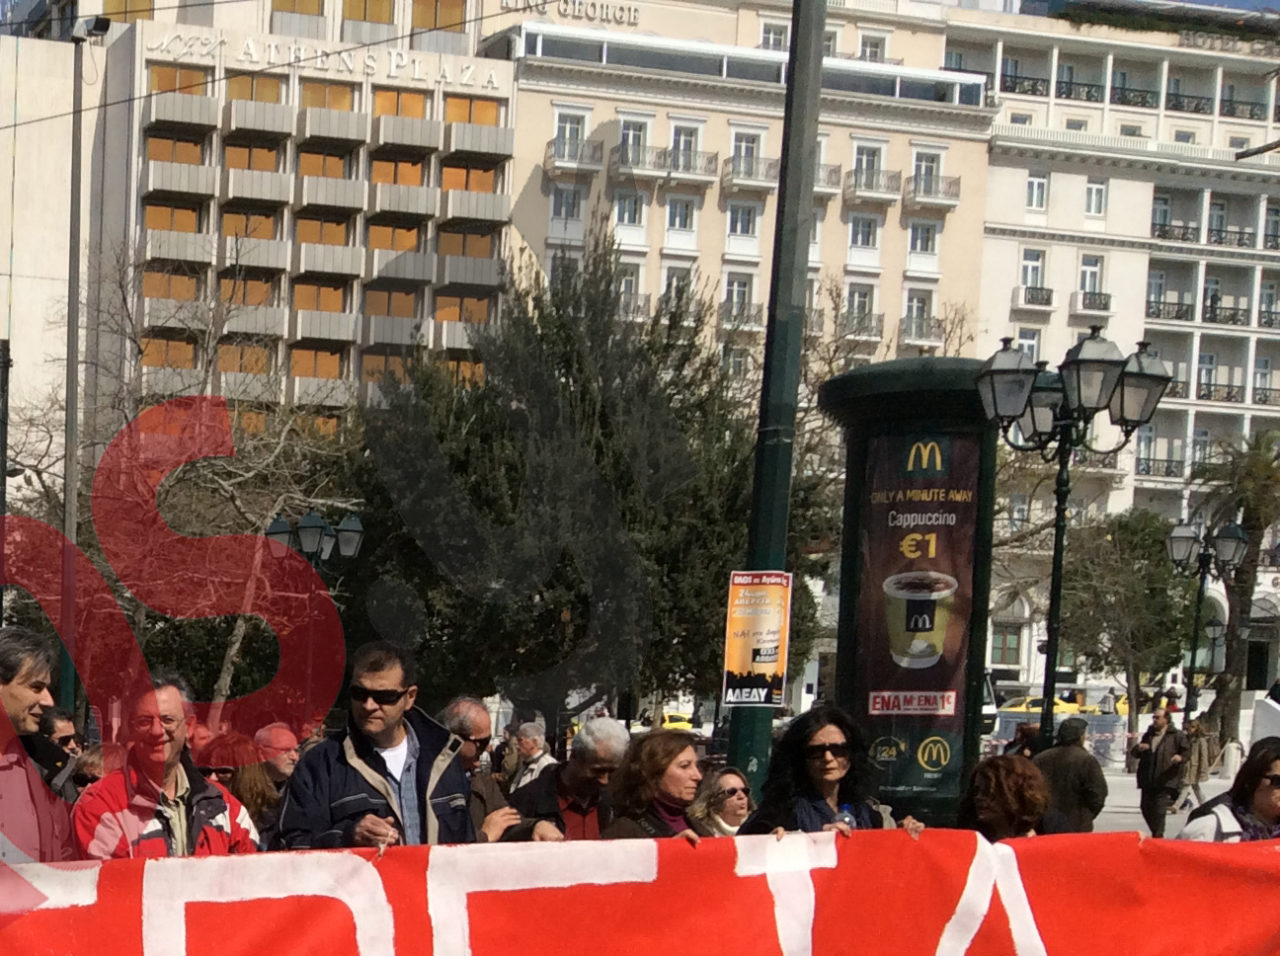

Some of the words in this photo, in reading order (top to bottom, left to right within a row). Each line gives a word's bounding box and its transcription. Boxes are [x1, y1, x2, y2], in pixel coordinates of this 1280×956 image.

[558, 0, 639, 27] GEORGE
[236, 38, 377, 78] ATHENS
[386, 48, 499, 90] PLAZA
[870, 490, 895, 504] ONLY
[895, 490, 905, 502] A
[906, 488, 946, 502] MINUTE
[948, 489, 973, 503] AWAY
[888, 510, 957, 529] Cappuccino
[899, 532, 937, 559] €1
[726, 688, 768, 703] ΑΔΕΔΥ
